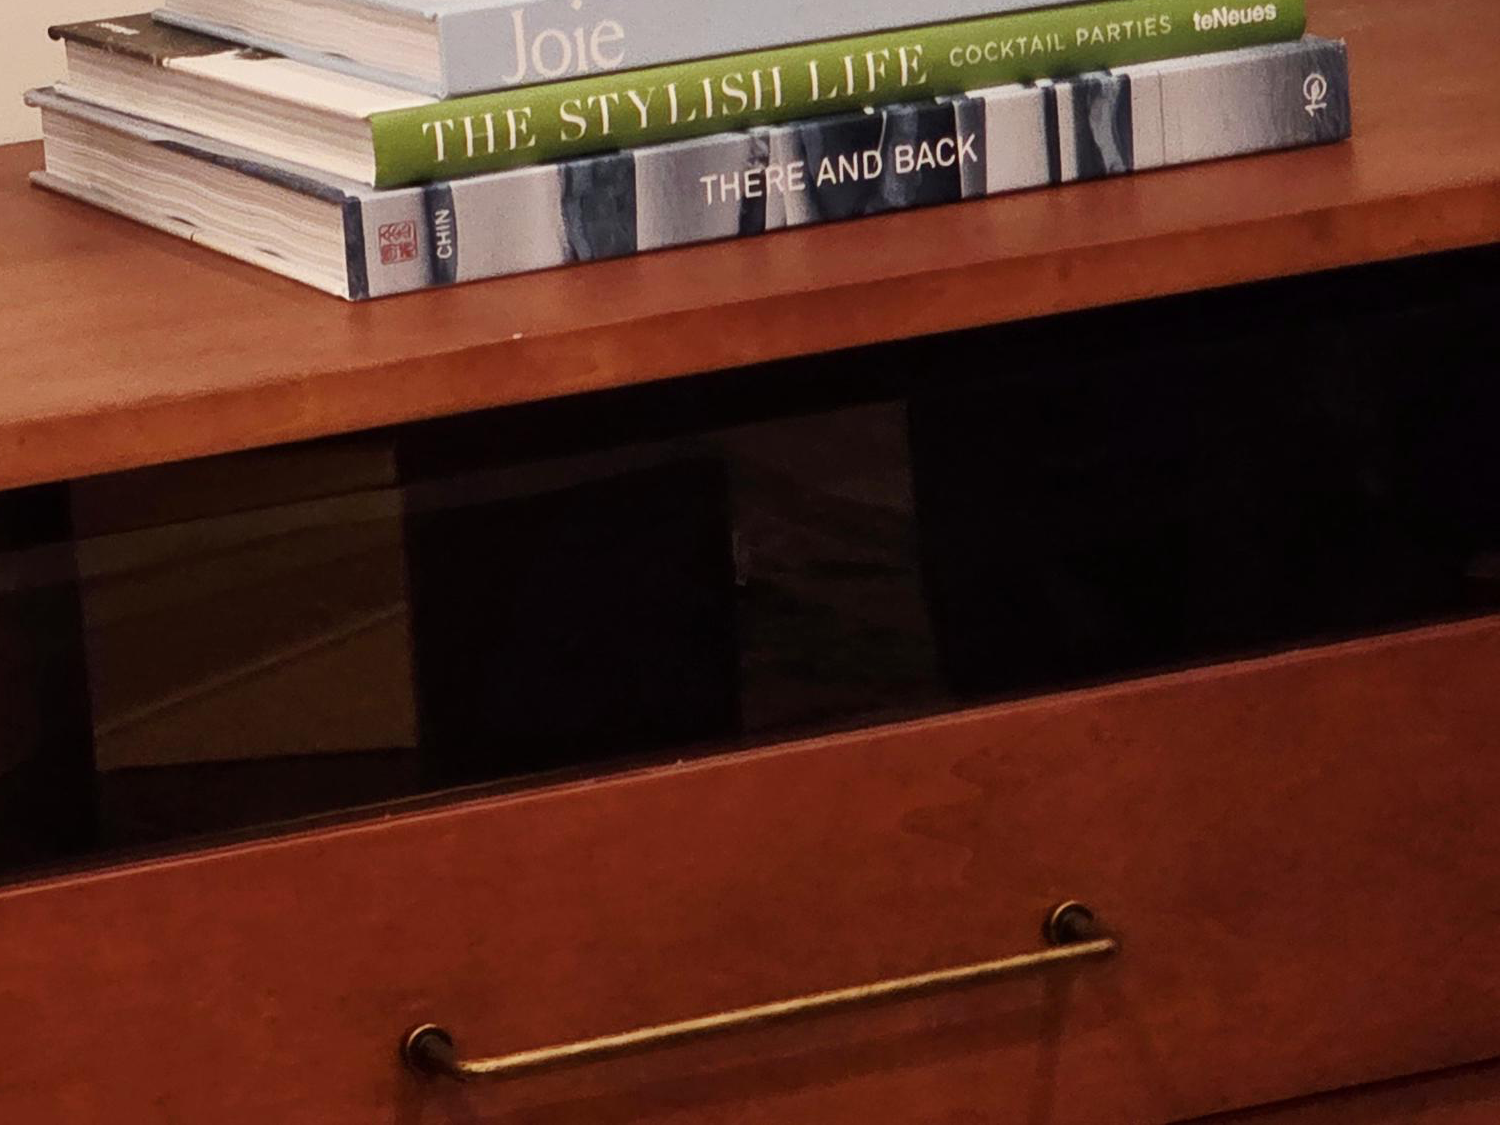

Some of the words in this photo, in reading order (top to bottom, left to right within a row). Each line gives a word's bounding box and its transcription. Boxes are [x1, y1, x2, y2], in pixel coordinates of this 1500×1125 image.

[949, 33, 1066, 67] COCKTAIL
[1076, 15, 1172, 46] PARTIES
[1193, 2, 1278, 32] teNeues
[422, 106, 536, 162] THE
[560, 65, 782, 142] STYLISH
[809, 44, 929, 102] LIFE
[699, 161, 806, 205] THERE
[816, 149, 882, 187] AND
[894, 133, 979, 175] BACK
[435, 208, 453, 259] CHIN
